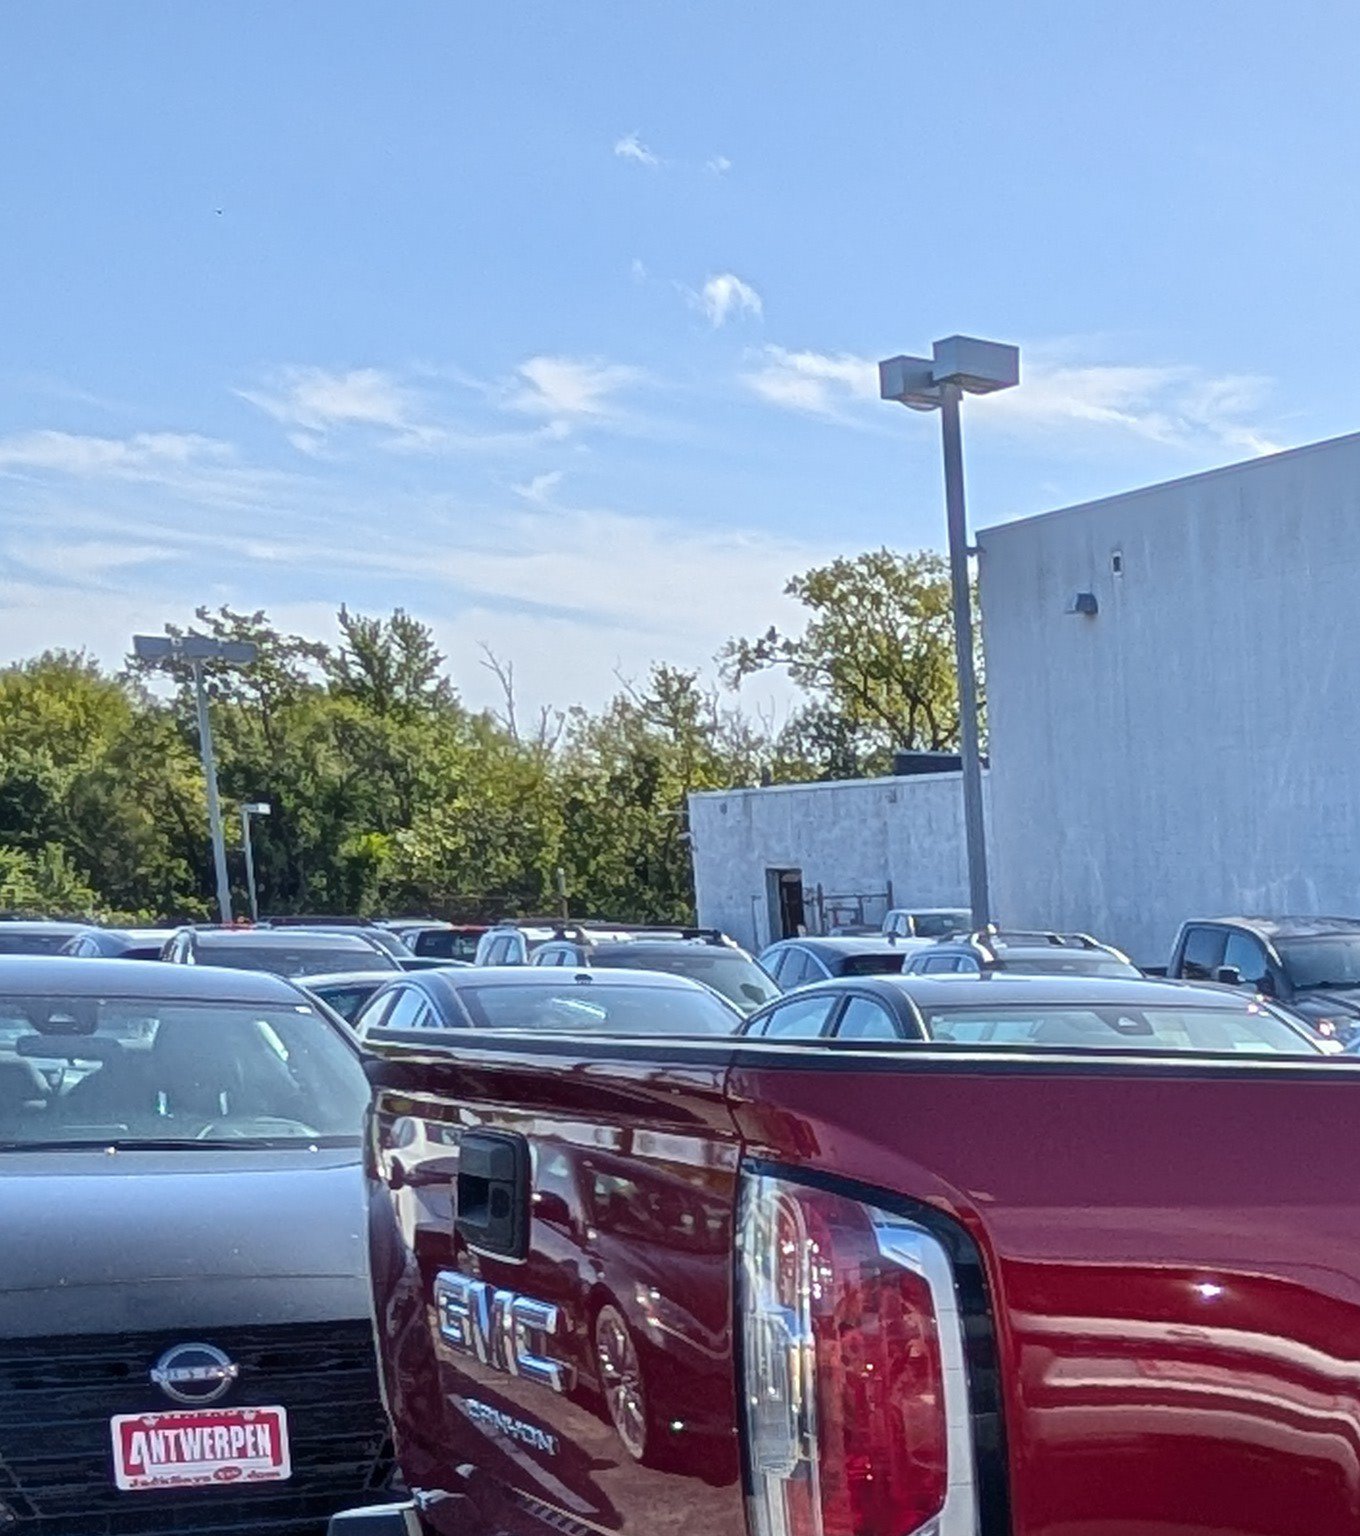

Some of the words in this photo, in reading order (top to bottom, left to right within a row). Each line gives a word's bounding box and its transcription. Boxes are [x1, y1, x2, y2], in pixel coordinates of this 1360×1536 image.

[434, 1270, 562, 1392] GMC
[129, 1423, 274, 1475] ANTWERPEN
[464, 1397, 557, 1456] CANYON
